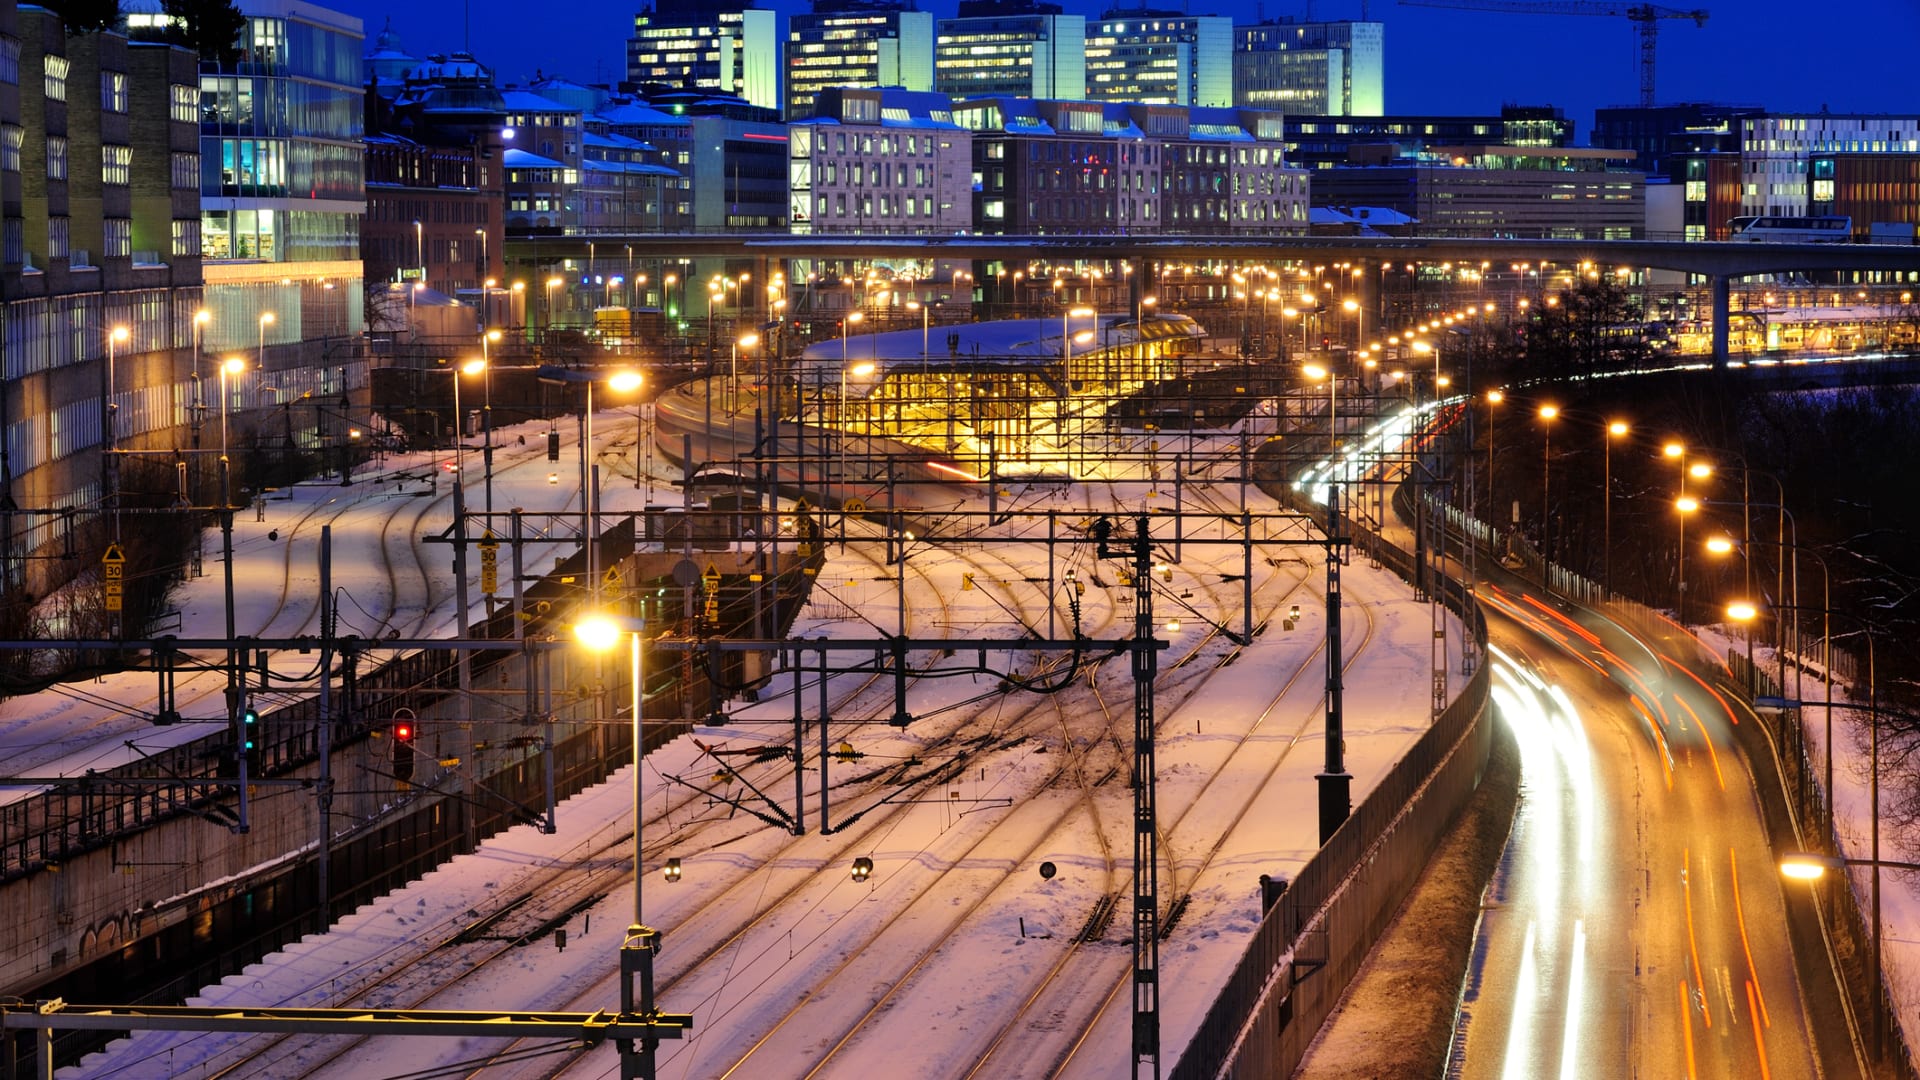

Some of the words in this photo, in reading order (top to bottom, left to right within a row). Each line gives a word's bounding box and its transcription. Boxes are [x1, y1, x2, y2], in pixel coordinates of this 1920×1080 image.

[482, 552, 496, 561] 30
[107, 566, 121, 576] 30
[706, 582, 718, 591] 30
